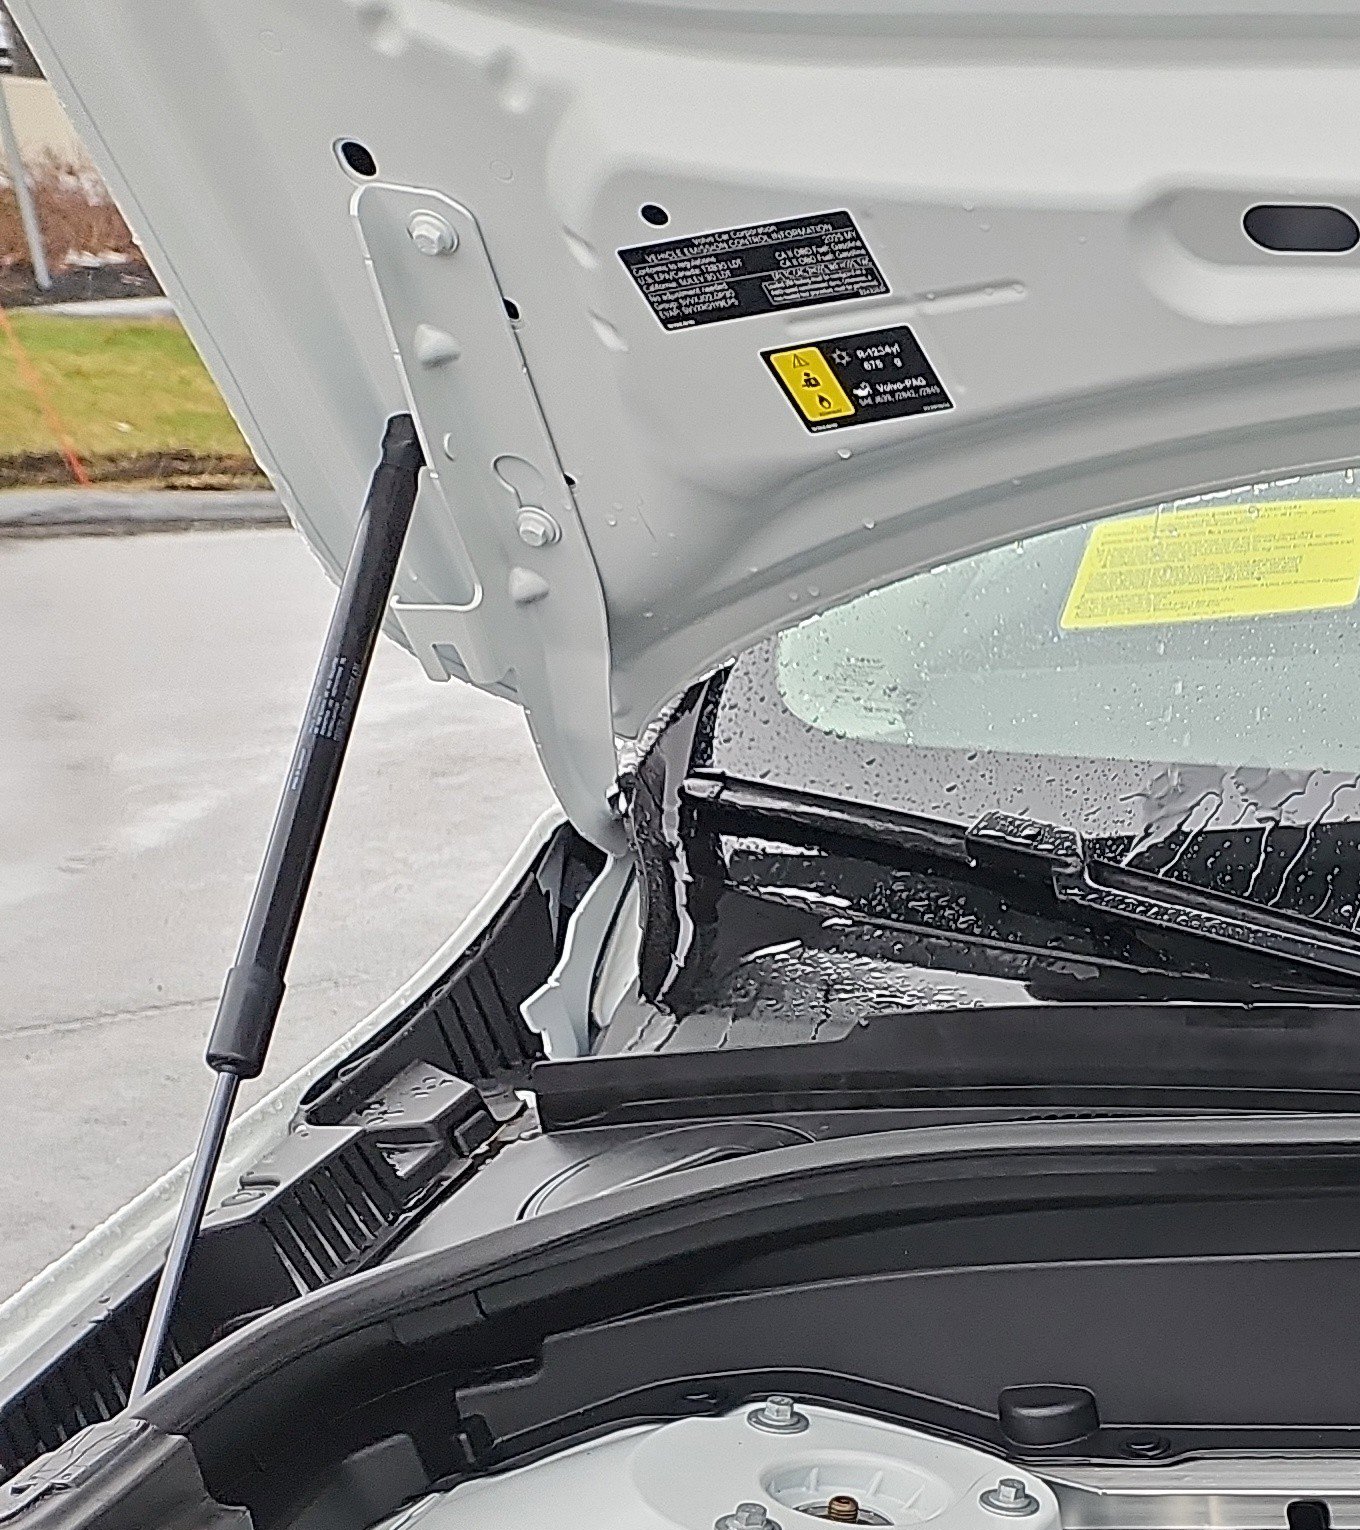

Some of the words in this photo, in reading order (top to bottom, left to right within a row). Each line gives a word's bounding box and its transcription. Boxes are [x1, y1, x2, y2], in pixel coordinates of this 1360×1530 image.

[645, 249, 684, 262] VEHICLE
[729, 235, 771, 248] CONTROL
[771, 224, 835, 241] INFORMATION
[857, 343, 900, 359] R-1234yf
